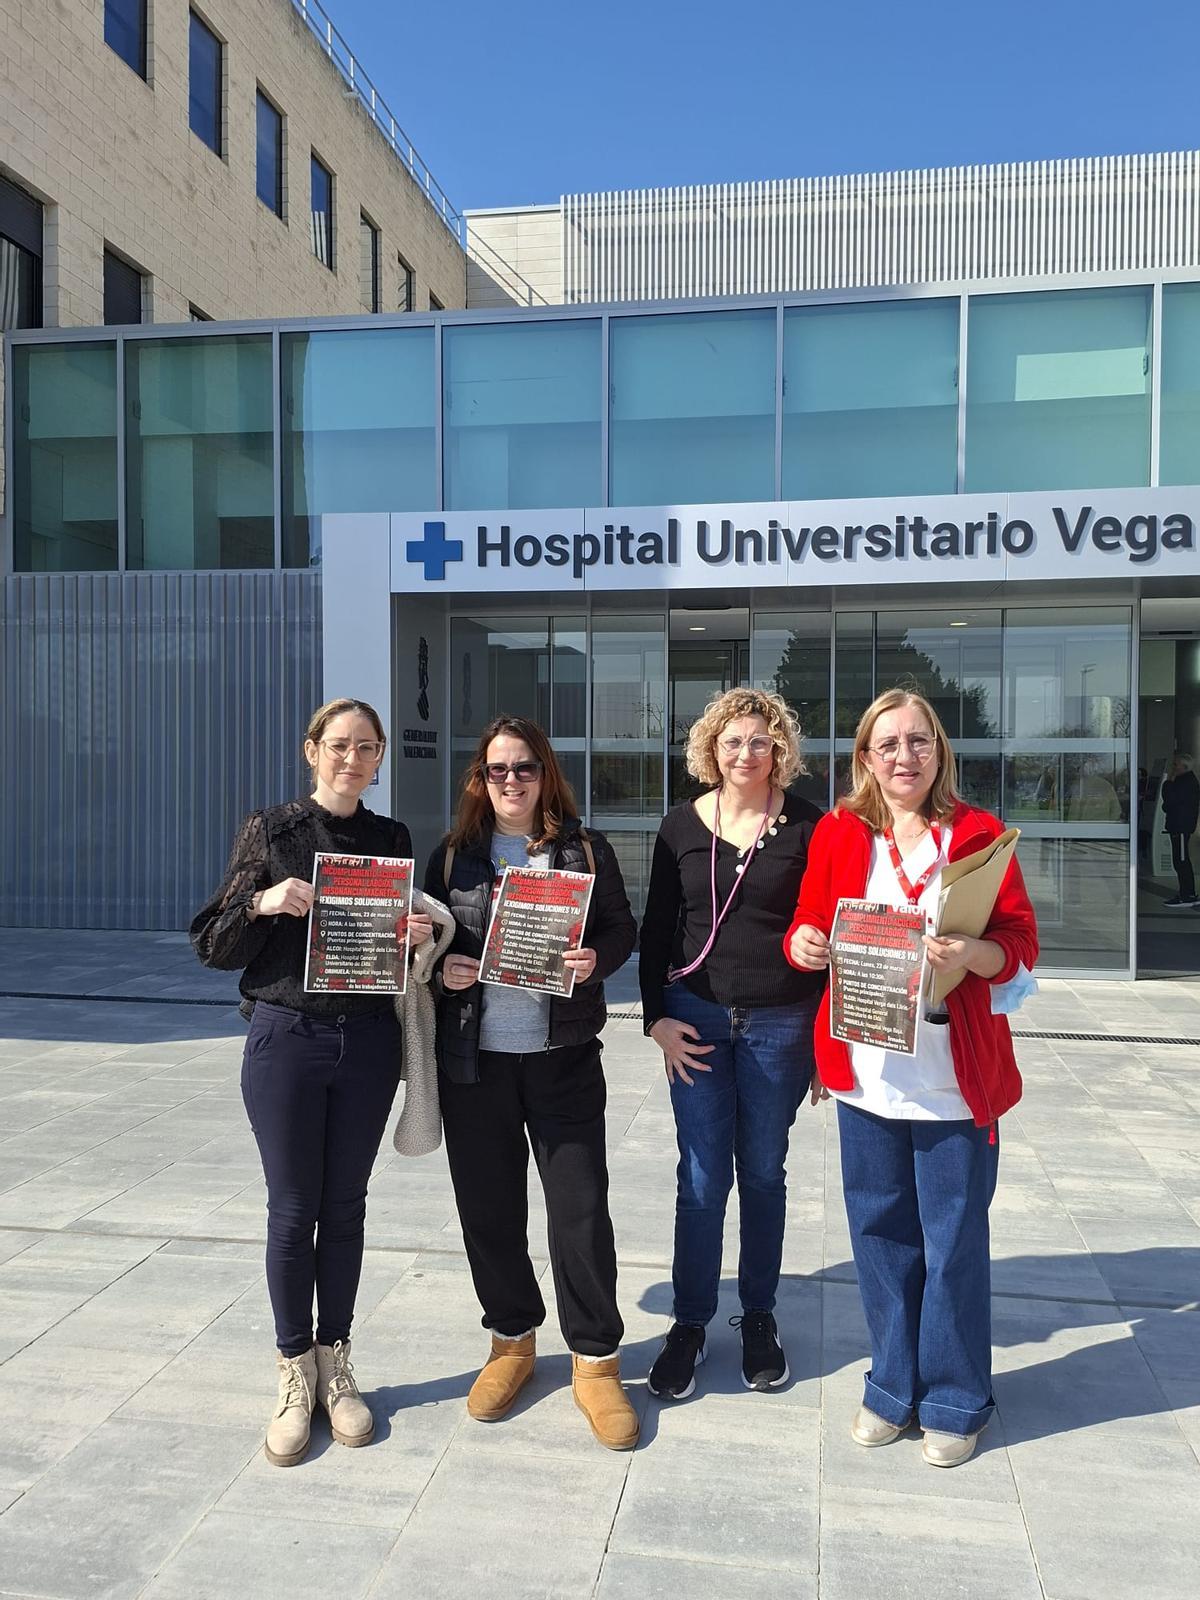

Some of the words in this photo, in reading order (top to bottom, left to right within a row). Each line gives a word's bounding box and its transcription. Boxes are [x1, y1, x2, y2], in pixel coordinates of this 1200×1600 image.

[477, 518, 678, 578] Hospital
[697, 512, 1034, 563] Universitario
[1052, 506, 1193, 562] Vega
[354, 897, 393, 907] SOLUCIONES
[393, 899, 404, 907] YA!
[534, 903, 570, 914] SOLUCIONES
[570, 907, 581, 915] YA!
[868, 946, 906, 960] SOLUCIONES
[907, 951, 918, 962] YA!
